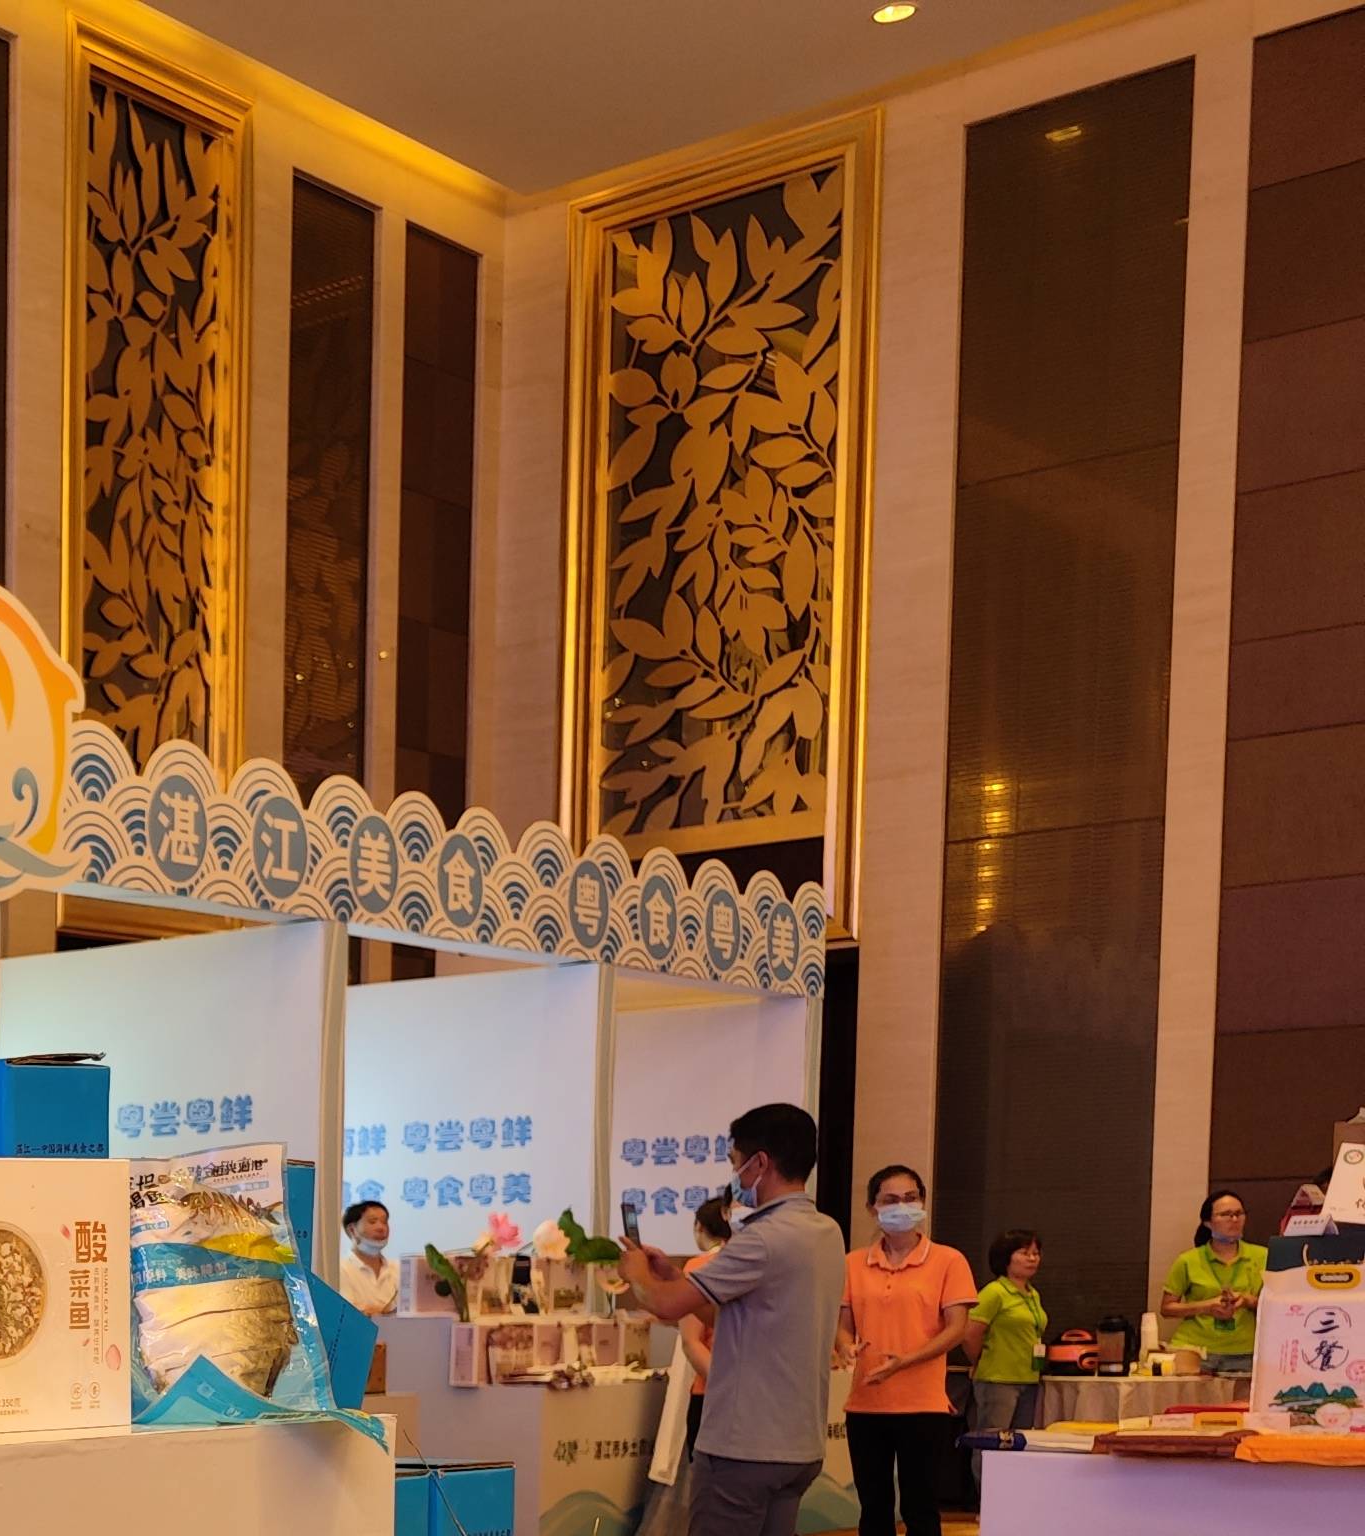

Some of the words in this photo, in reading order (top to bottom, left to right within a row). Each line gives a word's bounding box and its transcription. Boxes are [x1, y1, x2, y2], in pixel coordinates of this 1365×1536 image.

[115, 1094, 253, 1138] 粤尝粤鲜
[402, 1115, 532, 1153] 粤尝粤鲜
[401, 1171, 531, 1208] 粤食粤美
[621, 1185, 727, 1215] 粤食粤
